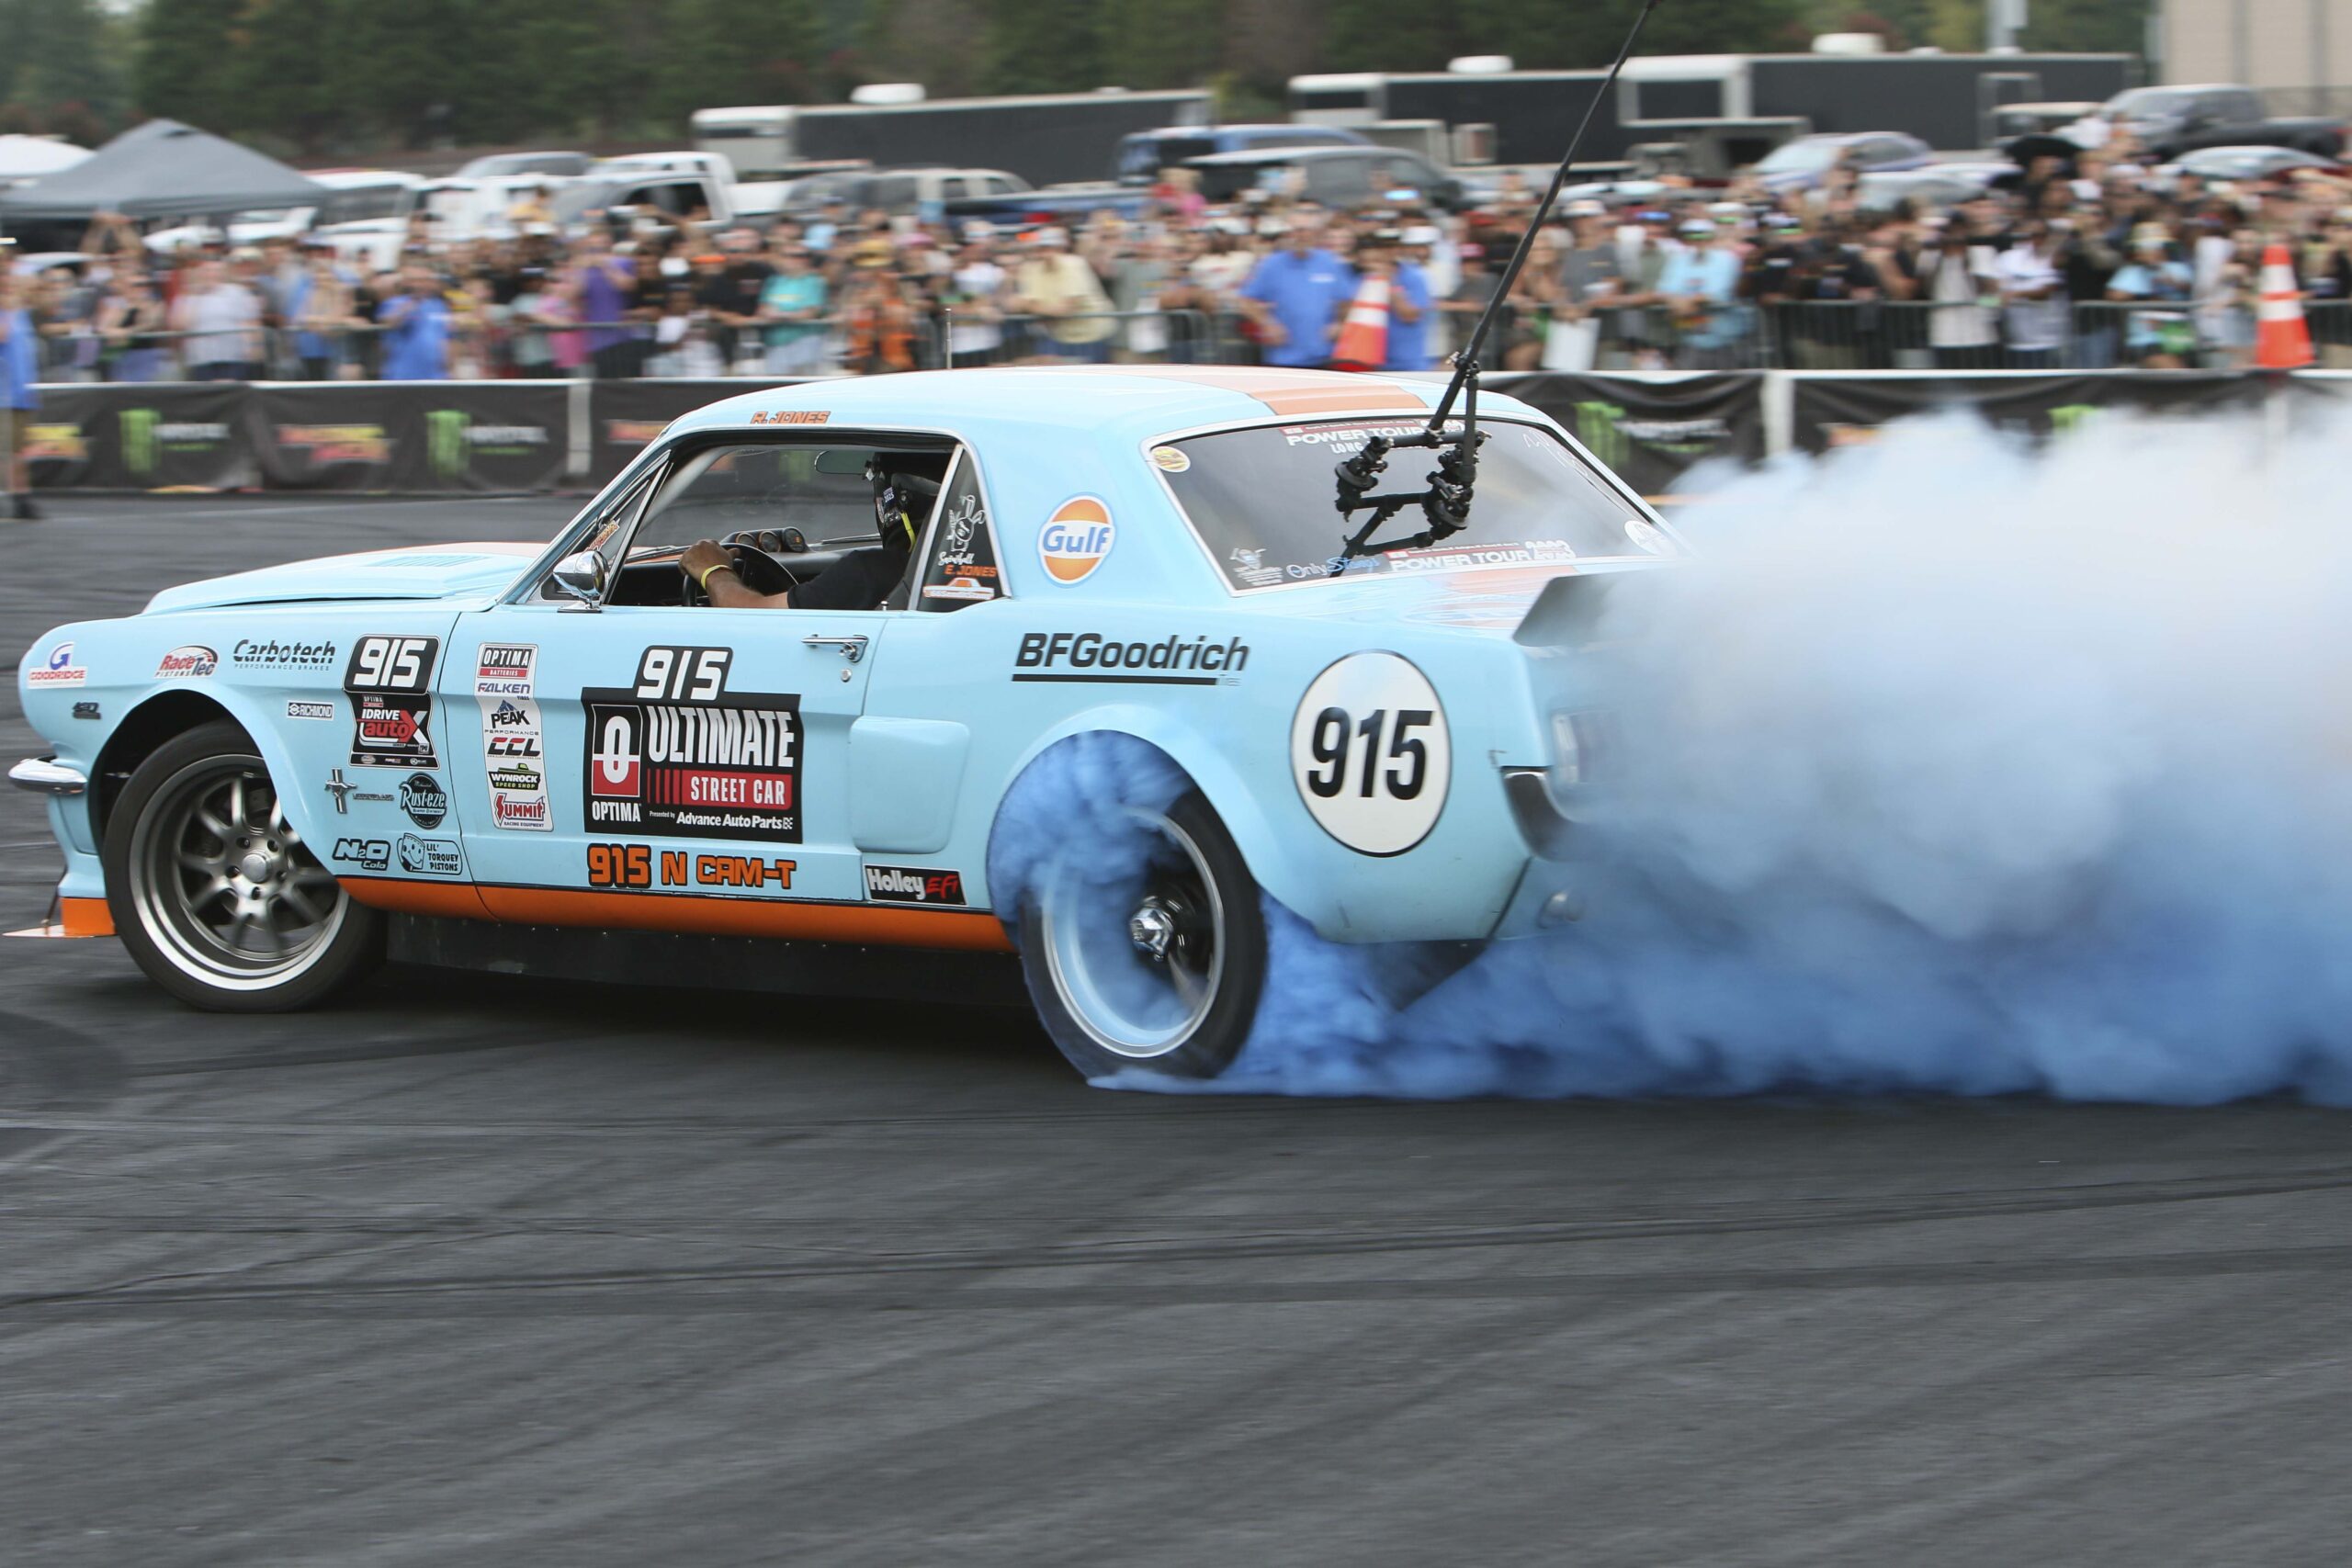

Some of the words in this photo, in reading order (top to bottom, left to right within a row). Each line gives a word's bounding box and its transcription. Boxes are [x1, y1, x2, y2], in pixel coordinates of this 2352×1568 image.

[750, 411, 831, 424] R.JONES
[1286, 428, 1371, 446] POWER
[1330, 441, 1364, 455] LONG
[1043, 525, 1111, 553] Gulf
[1389, 553, 1473, 571] POWER
[1473, 549, 1532, 564] TOUR
[233, 639, 336, 664] Carbotech
[483, 649, 530, 666] OPTIMA
[1015, 632, 1250, 671] BFGoodrich
[353, 637, 428, 688] 915
[28, 670, 85, 680] GOODRIDGE
[490, 669, 518, 677] BATTERIES
[637, 649, 729, 701] 915
[478, 682, 531, 694] FALKEN
[300, 704, 333, 716] RICHMOND
[361, 708, 401, 720] IDRIVE
[491, 710, 530, 729] PEAK
[647, 705, 795, 767] ULTIMATE
[487, 737, 541, 757] CCL
[1307, 706, 1436, 801] 915
[491, 773, 538, 784] WYNROCK
[691, 775, 747, 803] STREET
[752, 779, 786, 805] CAR
[592, 801, 641, 822] OPTIMA
[676, 811, 721, 826] Advance
[722, 814, 752, 828] Auto
[751, 815, 783, 829] Parts
[363, 861, 387, 869] Cola
[428, 852, 458, 863] TORQUEY
[430, 862, 458, 872] PISTONS
[588, 845, 650, 887] 915
[662, 852, 688, 886] N
[696, 855, 797, 889] CAM-T
[866, 868, 926, 900] Holley
